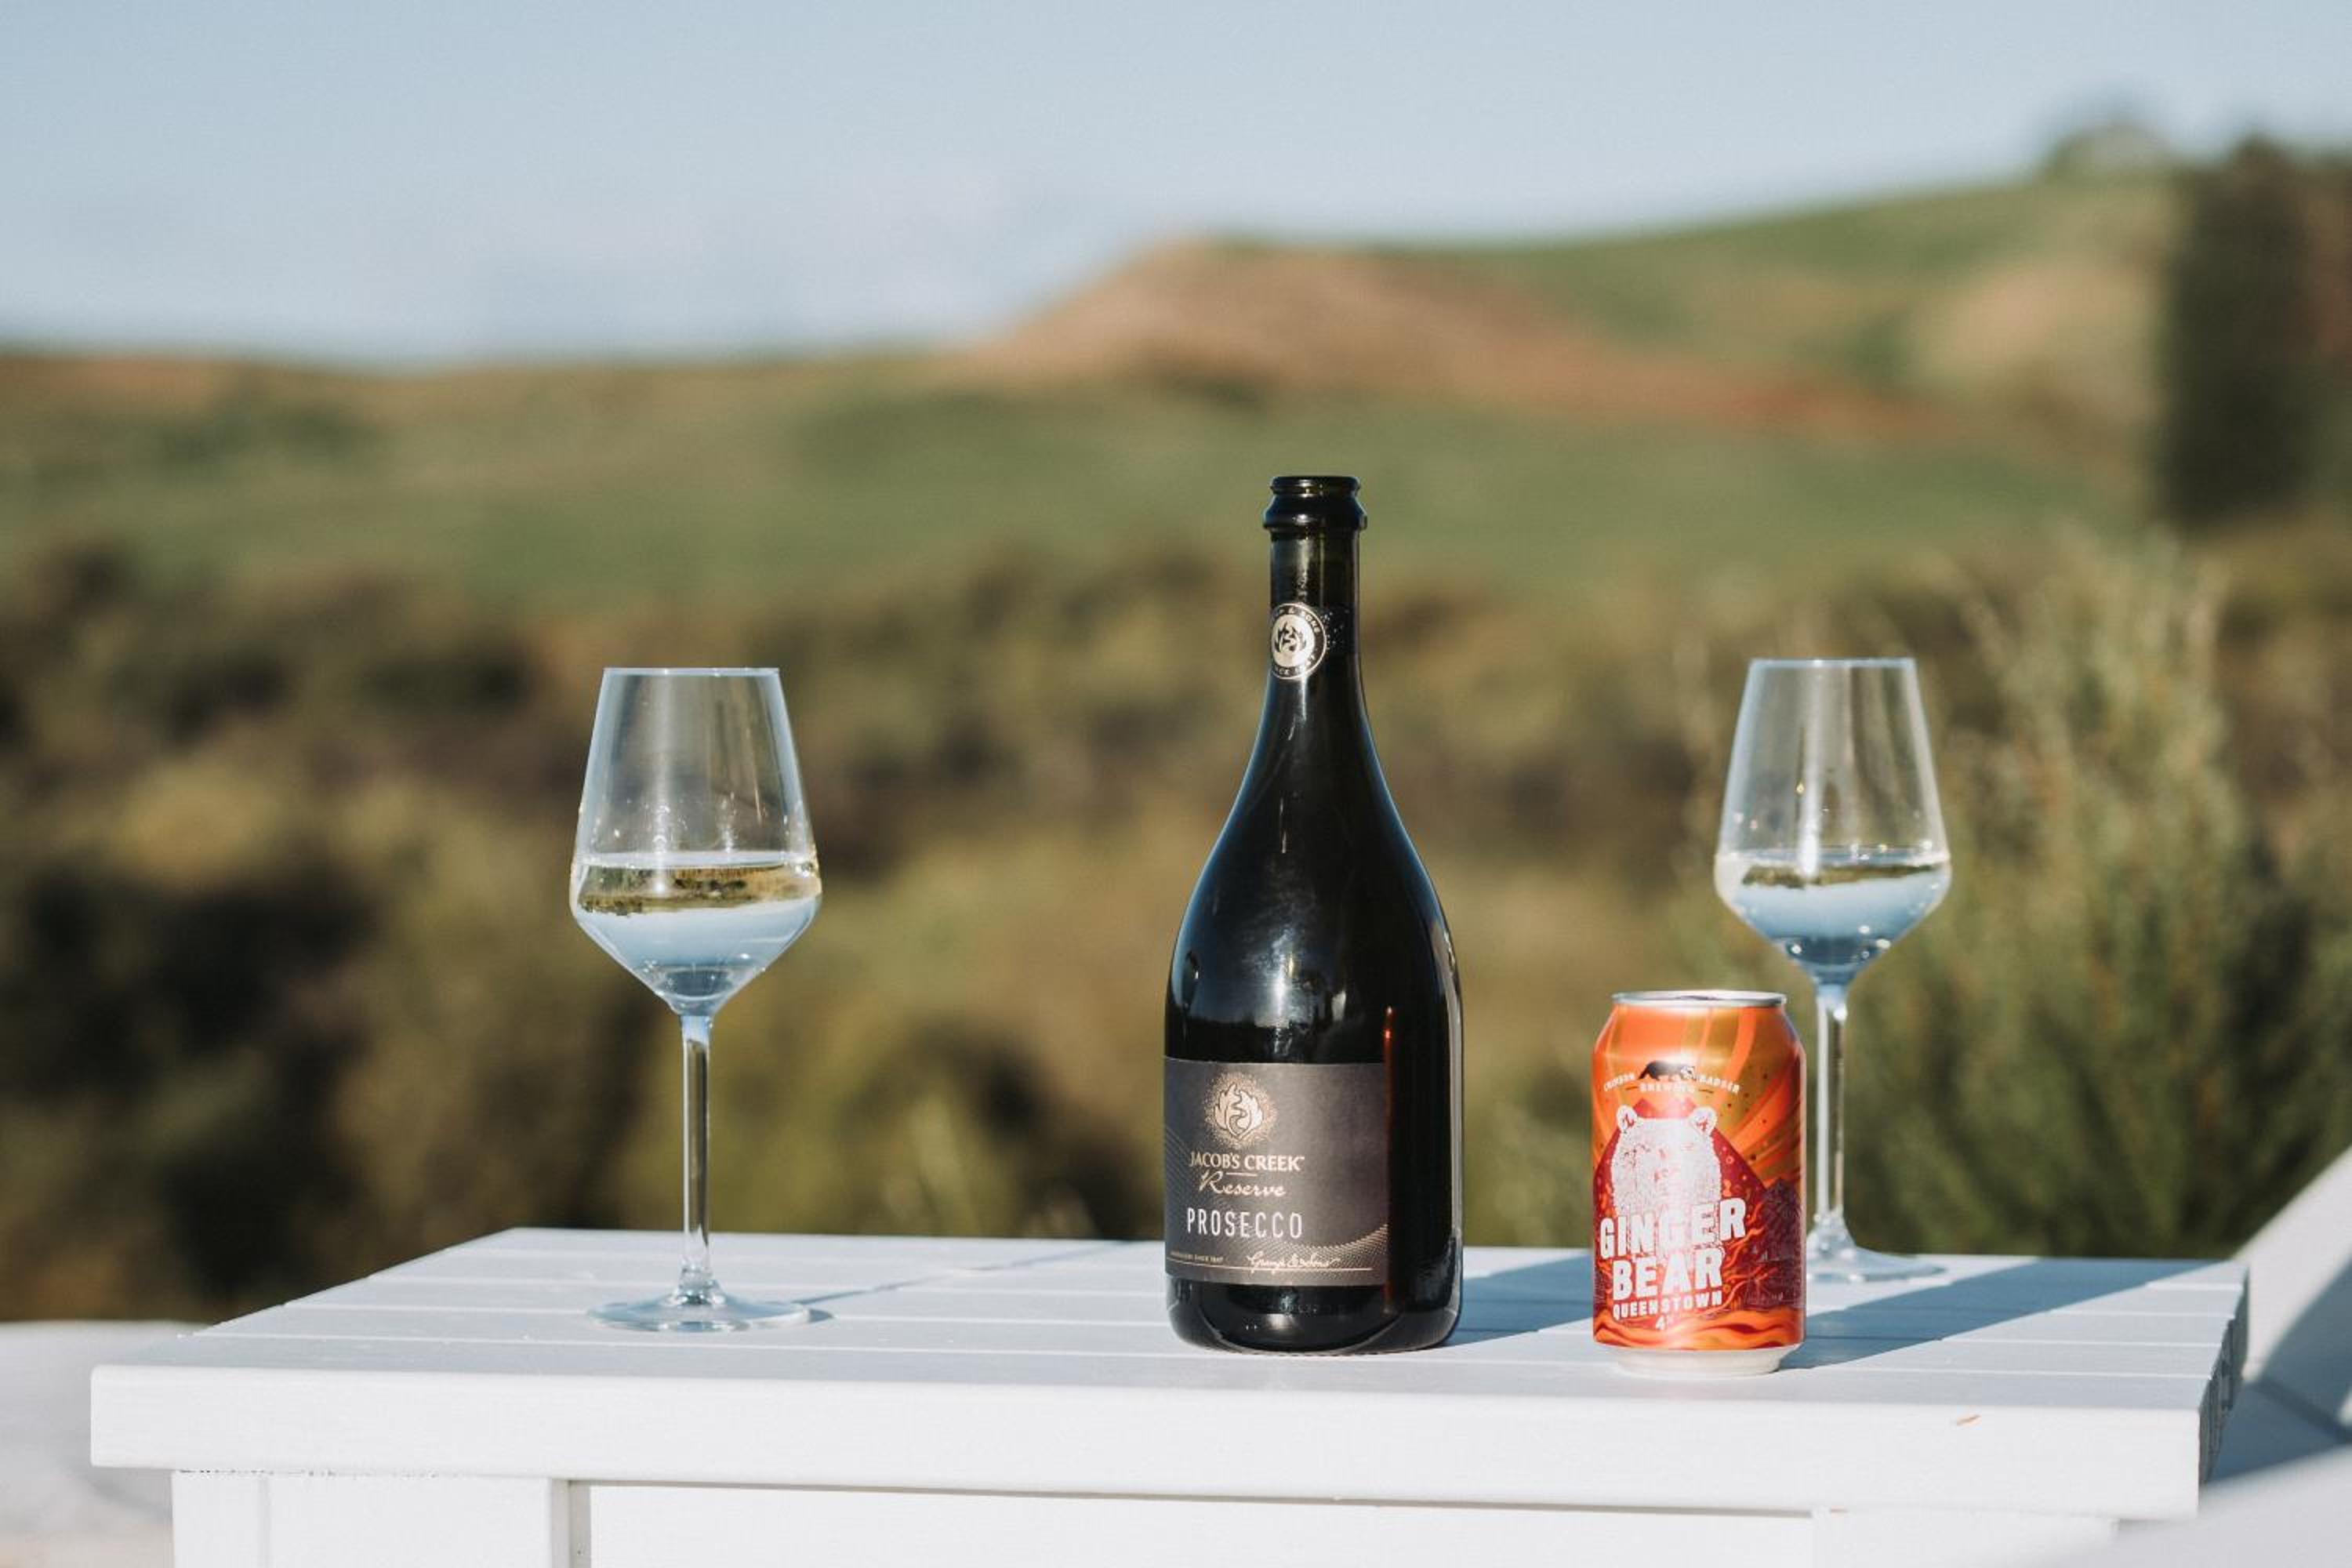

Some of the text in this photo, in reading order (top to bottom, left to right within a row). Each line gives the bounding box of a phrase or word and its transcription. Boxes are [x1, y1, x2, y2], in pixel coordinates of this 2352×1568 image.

[1189, 1151, 1301, 1171] JACOB'S CREEK
[1199, 1170, 1287, 1197] Reserve
[1187, 1207, 1303, 1239] PROSECCO
[1599, 1197, 1747, 1259] GINGER
[1613, 1248, 1723, 1301] BEAR
[1613, 1290, 1723, 1320] QUEENSTOWN
